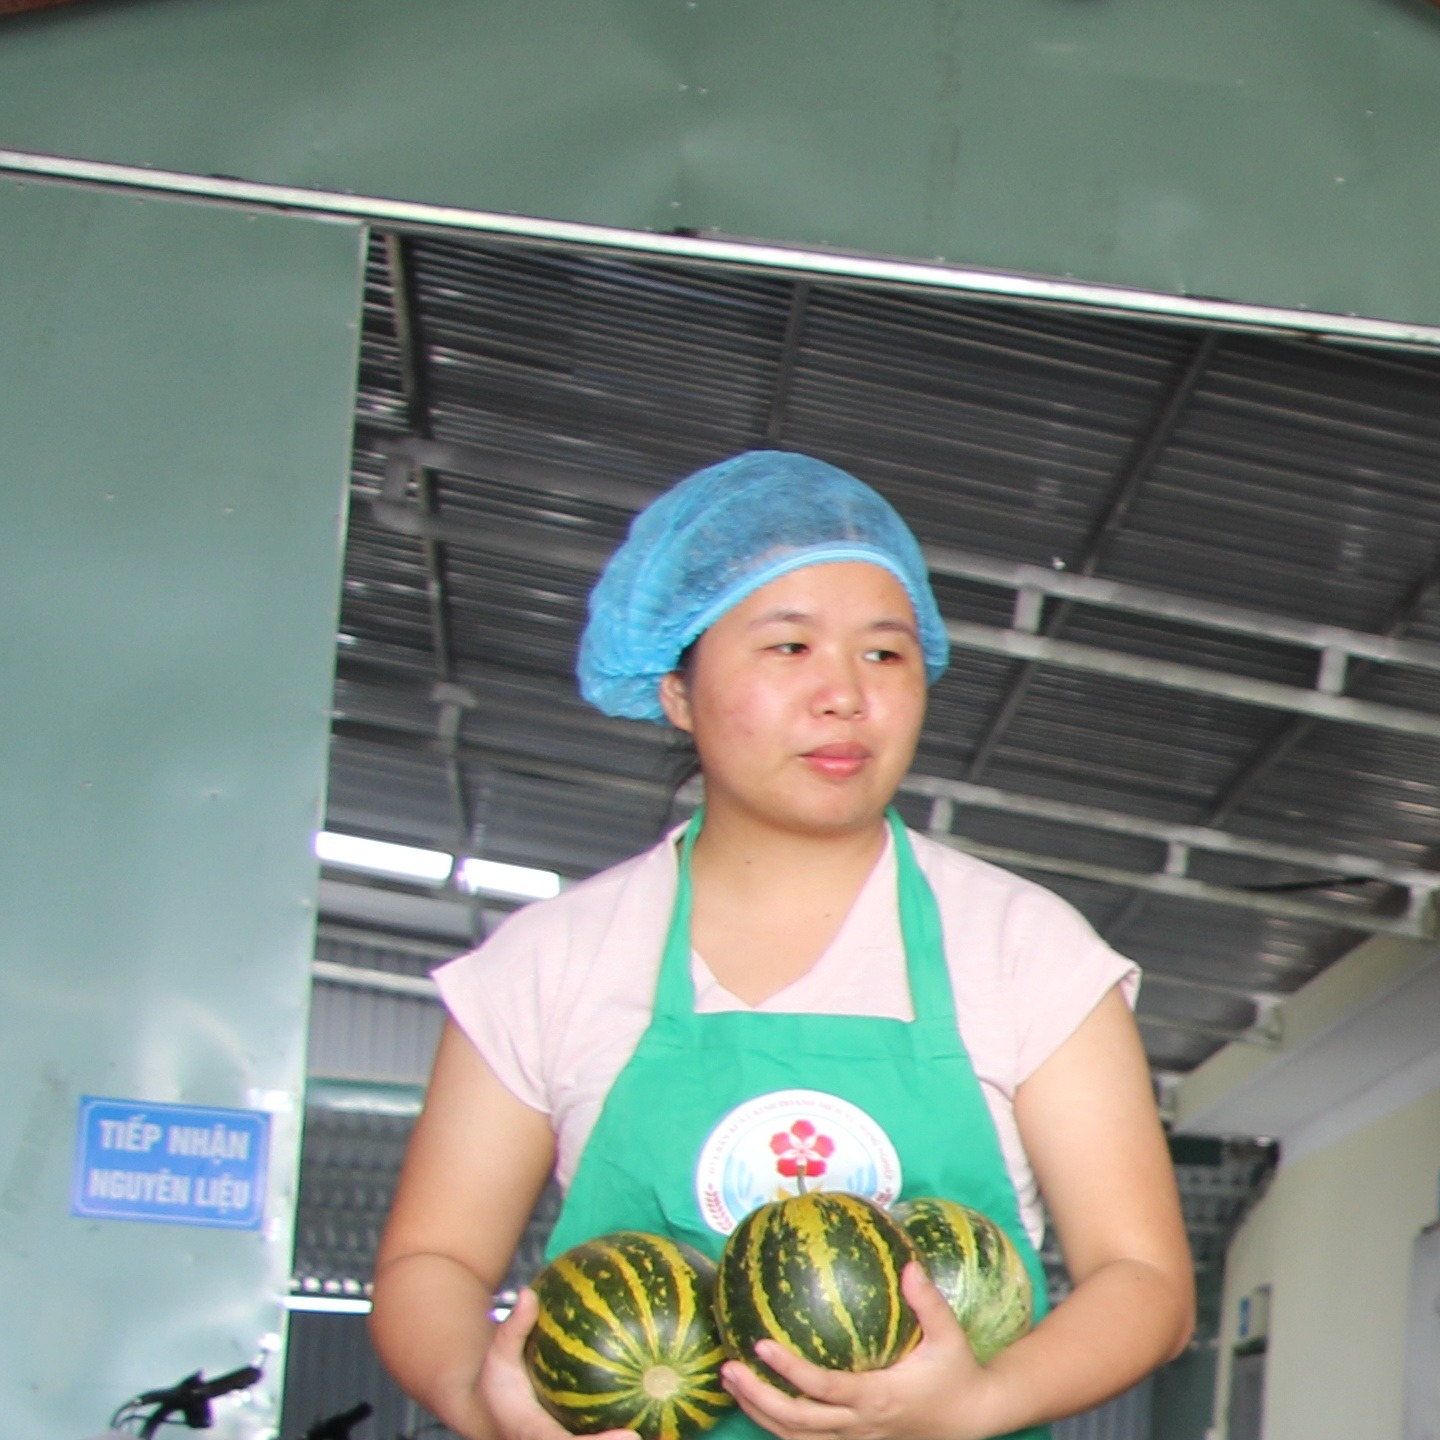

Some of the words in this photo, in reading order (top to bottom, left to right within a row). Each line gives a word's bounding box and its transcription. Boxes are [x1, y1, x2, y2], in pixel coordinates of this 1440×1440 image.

[99, 1114, 162, 1152] TIẾP
[168, 1123, 249, 1165] NHẬN
[88, 1168, 191, 1205] NGUYÊN
[194, 1172, 249, 1214] LIỆU
